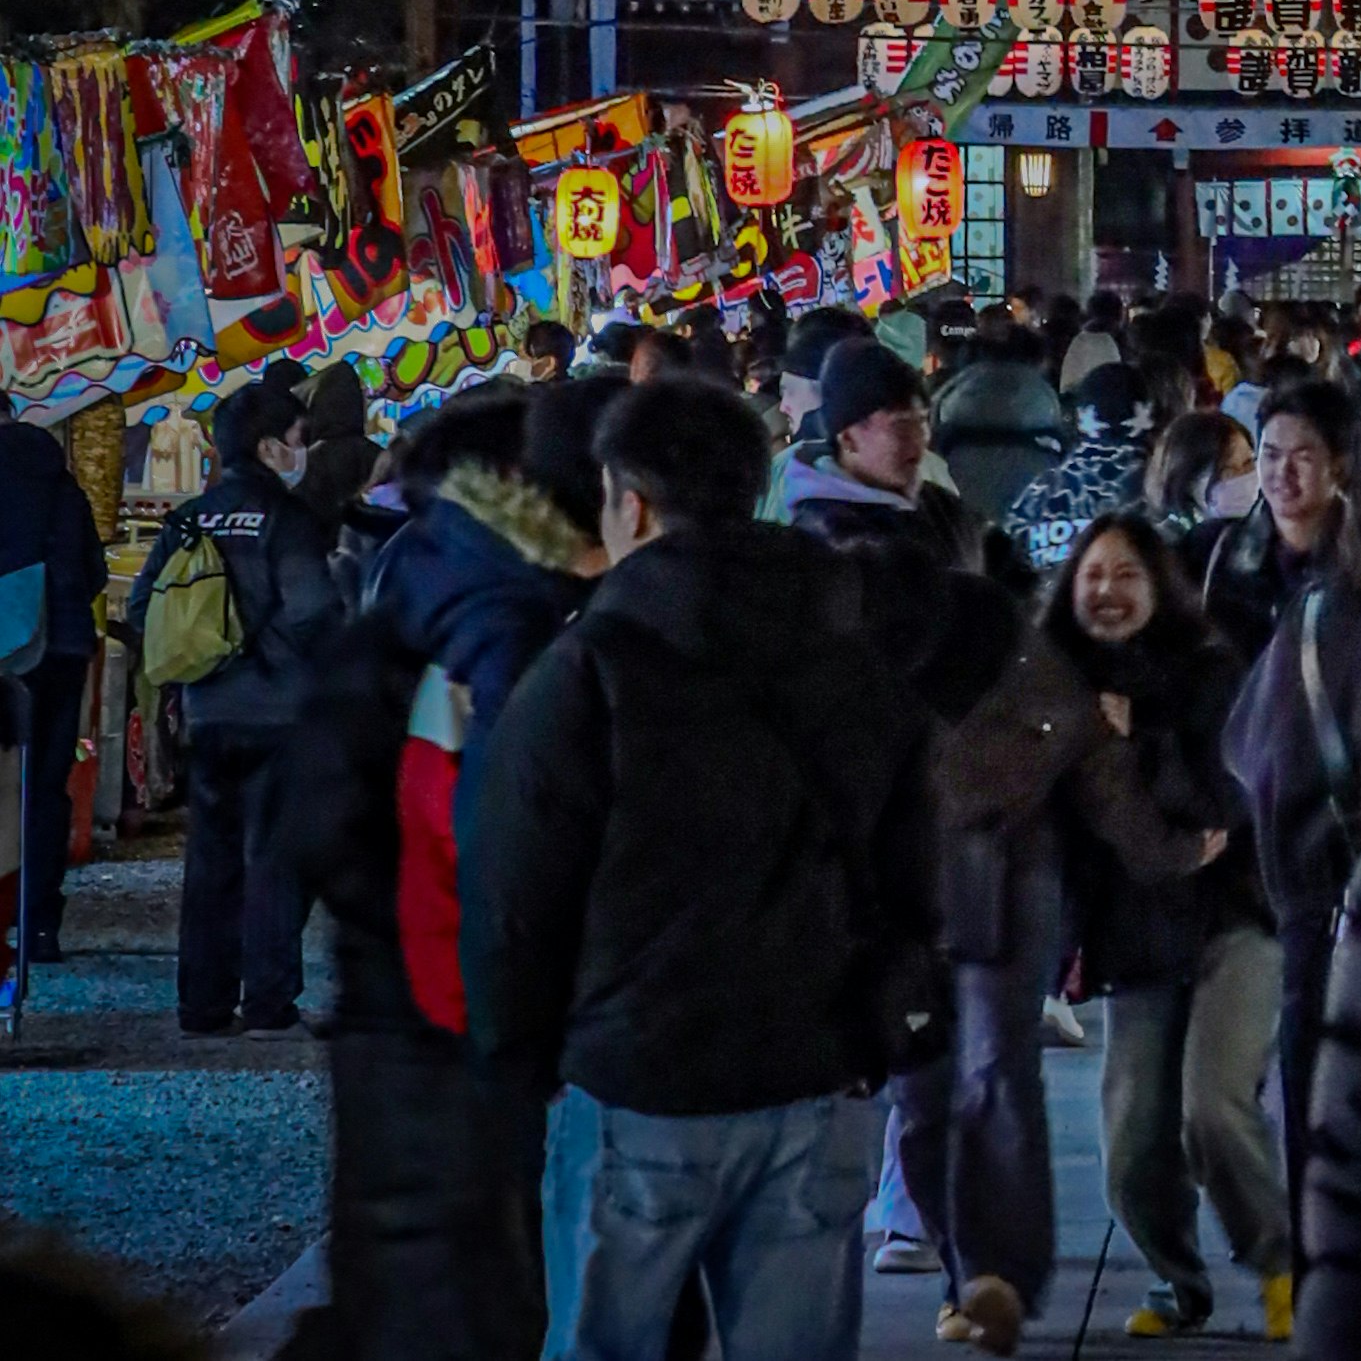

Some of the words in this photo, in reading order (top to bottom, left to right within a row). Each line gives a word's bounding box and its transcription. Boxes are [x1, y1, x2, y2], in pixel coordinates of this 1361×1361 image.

[990, 113, 1073, 141] 帰路
[730, 128, 760, 196] たこ焼
[922, 144, 952, 226] たこ焼
